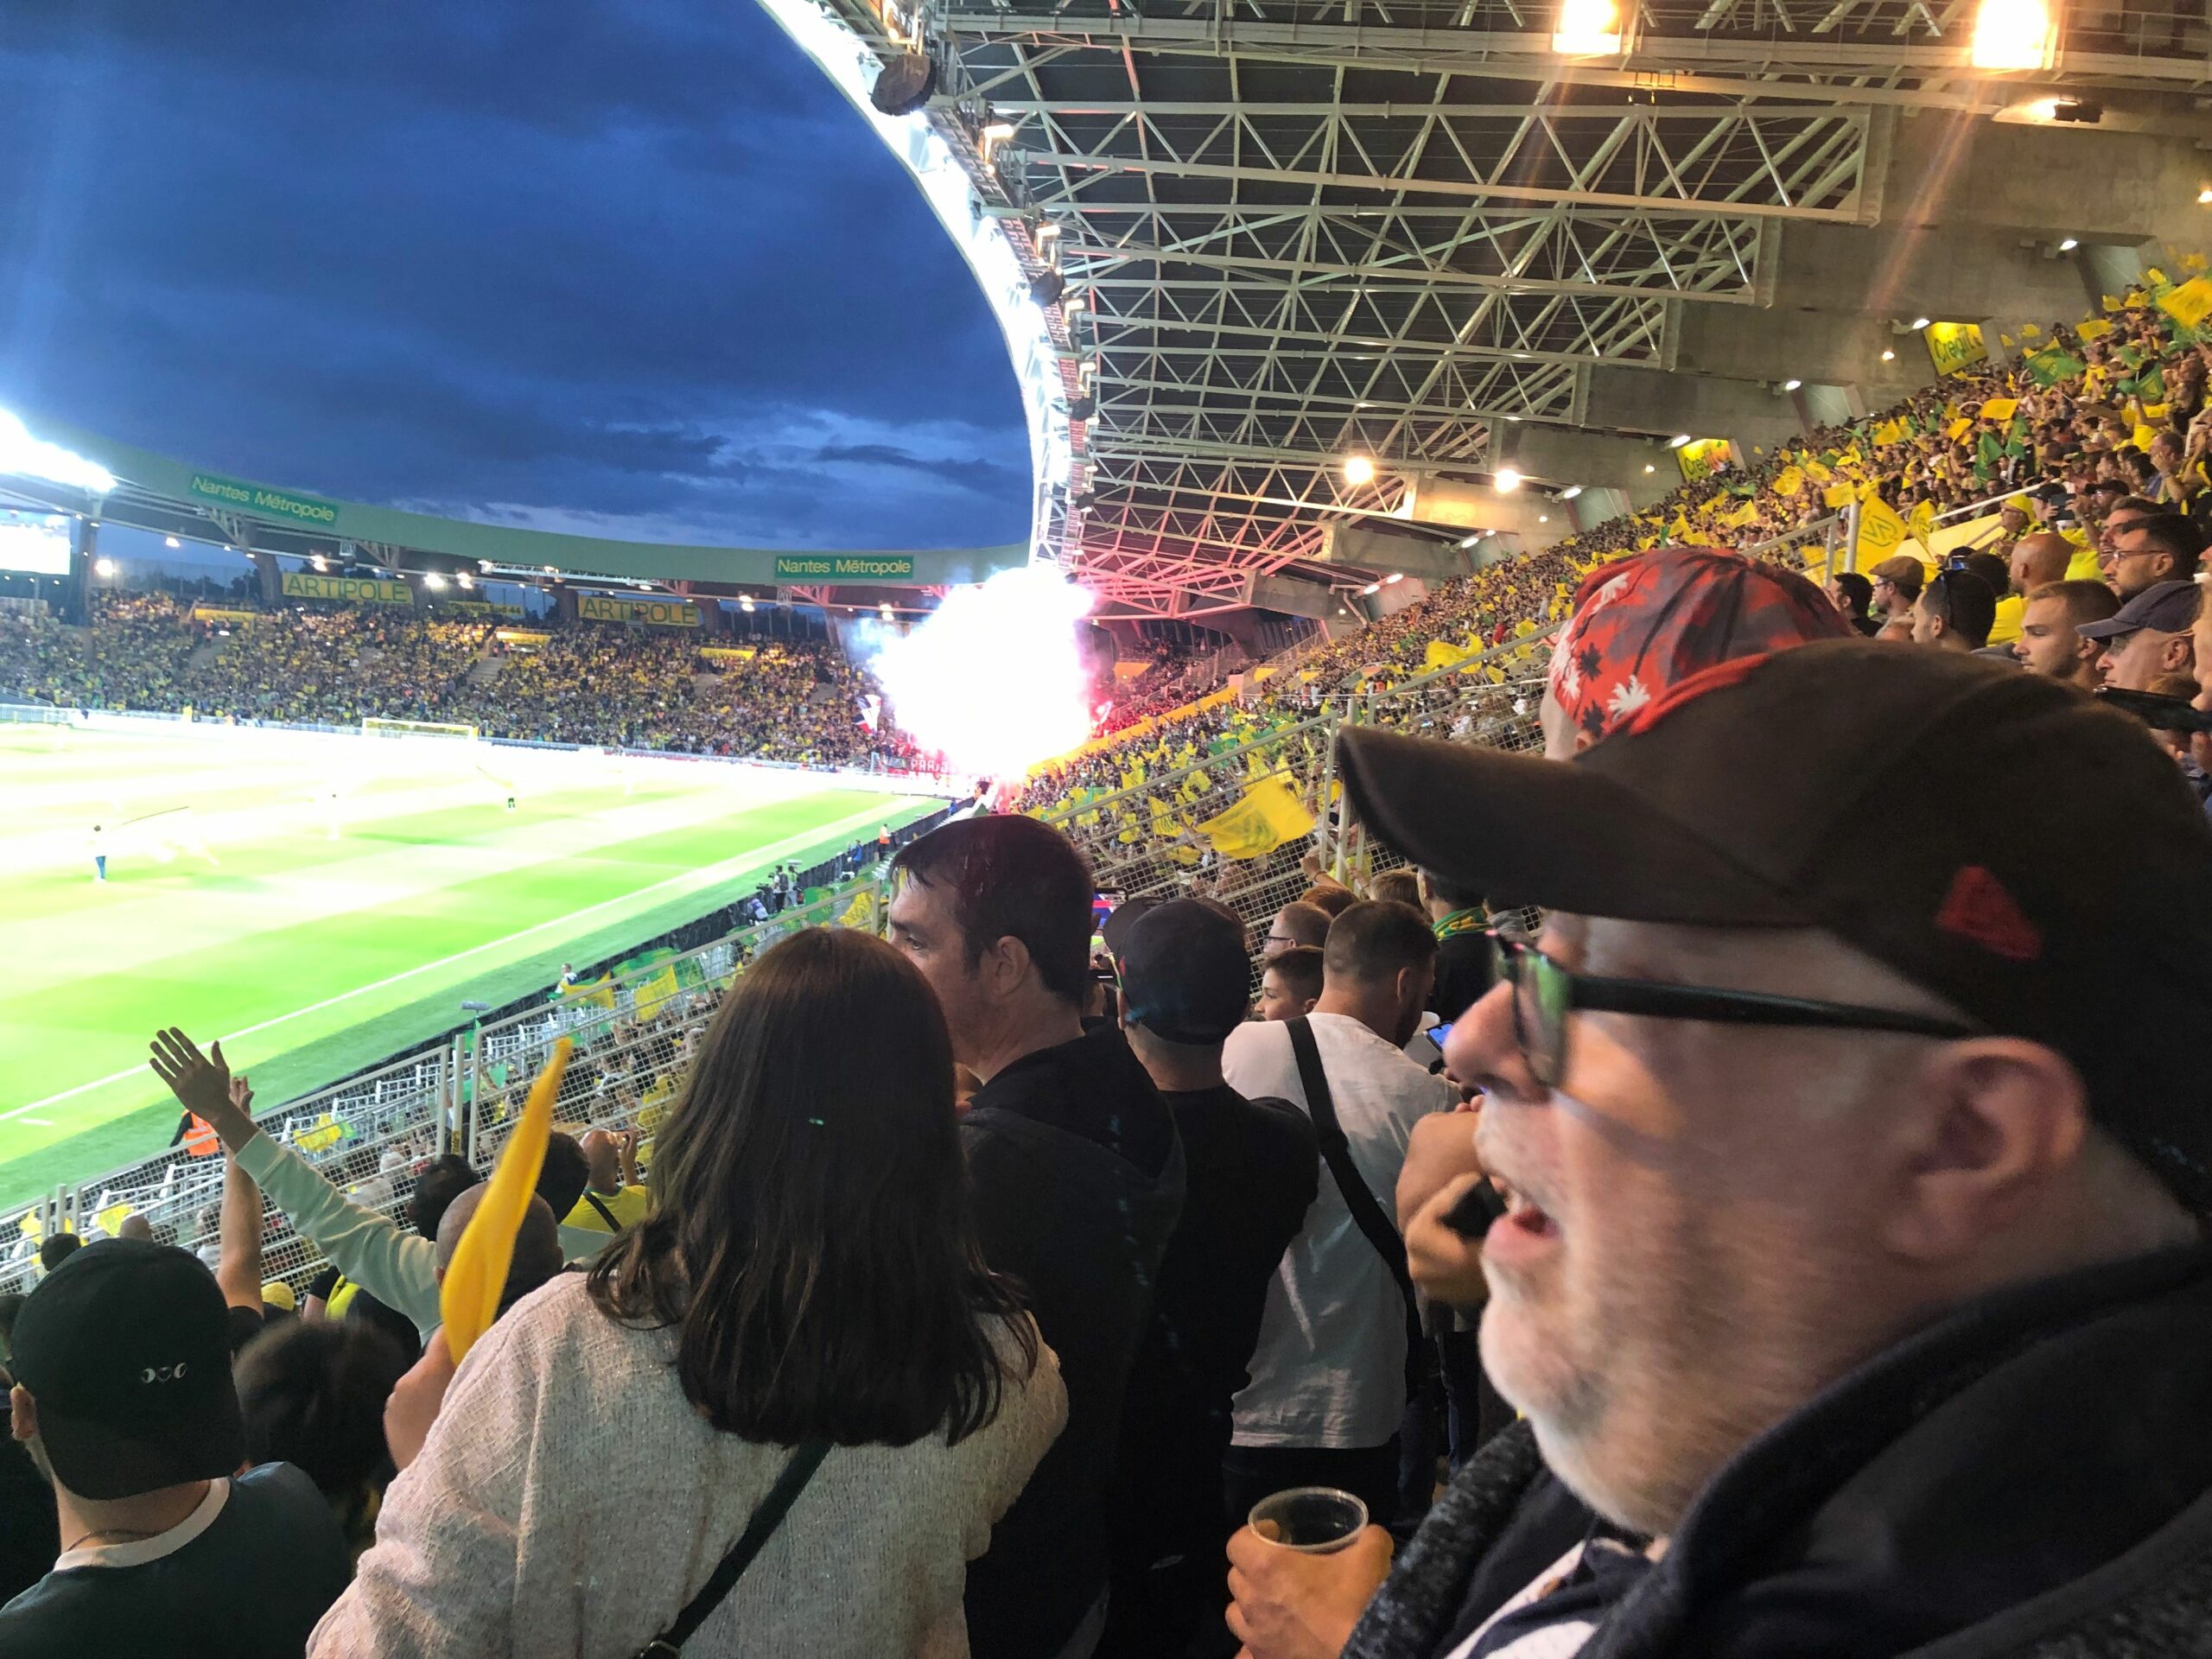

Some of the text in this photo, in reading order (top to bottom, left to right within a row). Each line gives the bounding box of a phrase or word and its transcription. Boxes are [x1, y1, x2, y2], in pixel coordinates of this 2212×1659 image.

[192, 476, 334, 521] Nantes Métropole
[778, 559, 912, 576] Nantes Métropole
[288, 575, 407, 602] ARTIPOLE
[582, 598, 696, 624] ARTIPOLE
